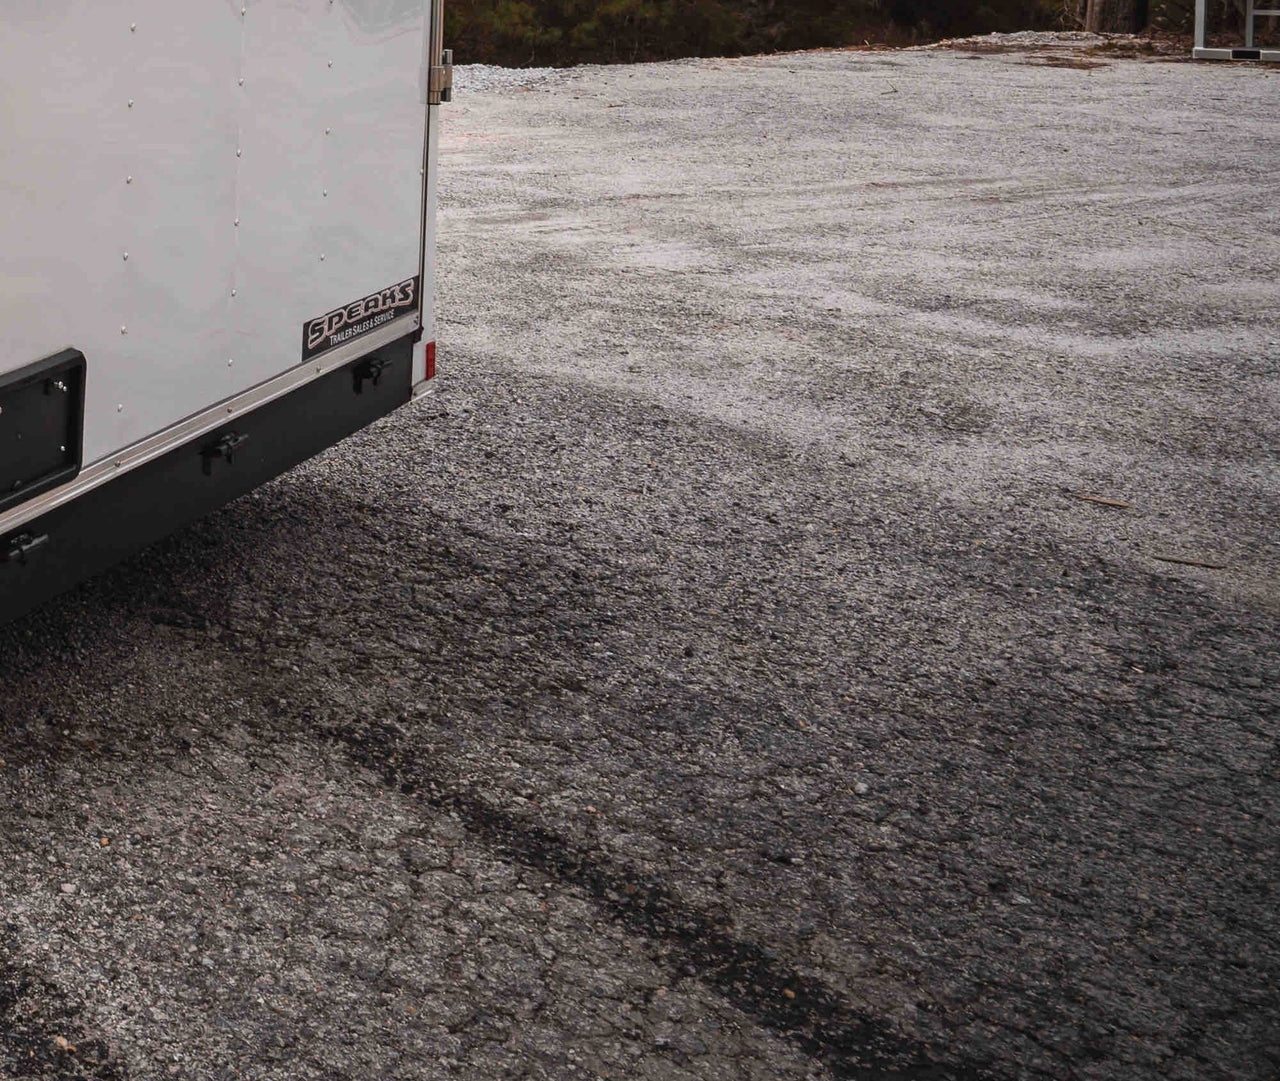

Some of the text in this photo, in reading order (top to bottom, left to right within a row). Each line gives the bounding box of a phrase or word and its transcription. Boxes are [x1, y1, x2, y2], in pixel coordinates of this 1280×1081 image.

[329, 328, 352, 346] TRAILER
[352, 320, 370, 336] SALES
[373, 309, 395, 326] SERVICE
